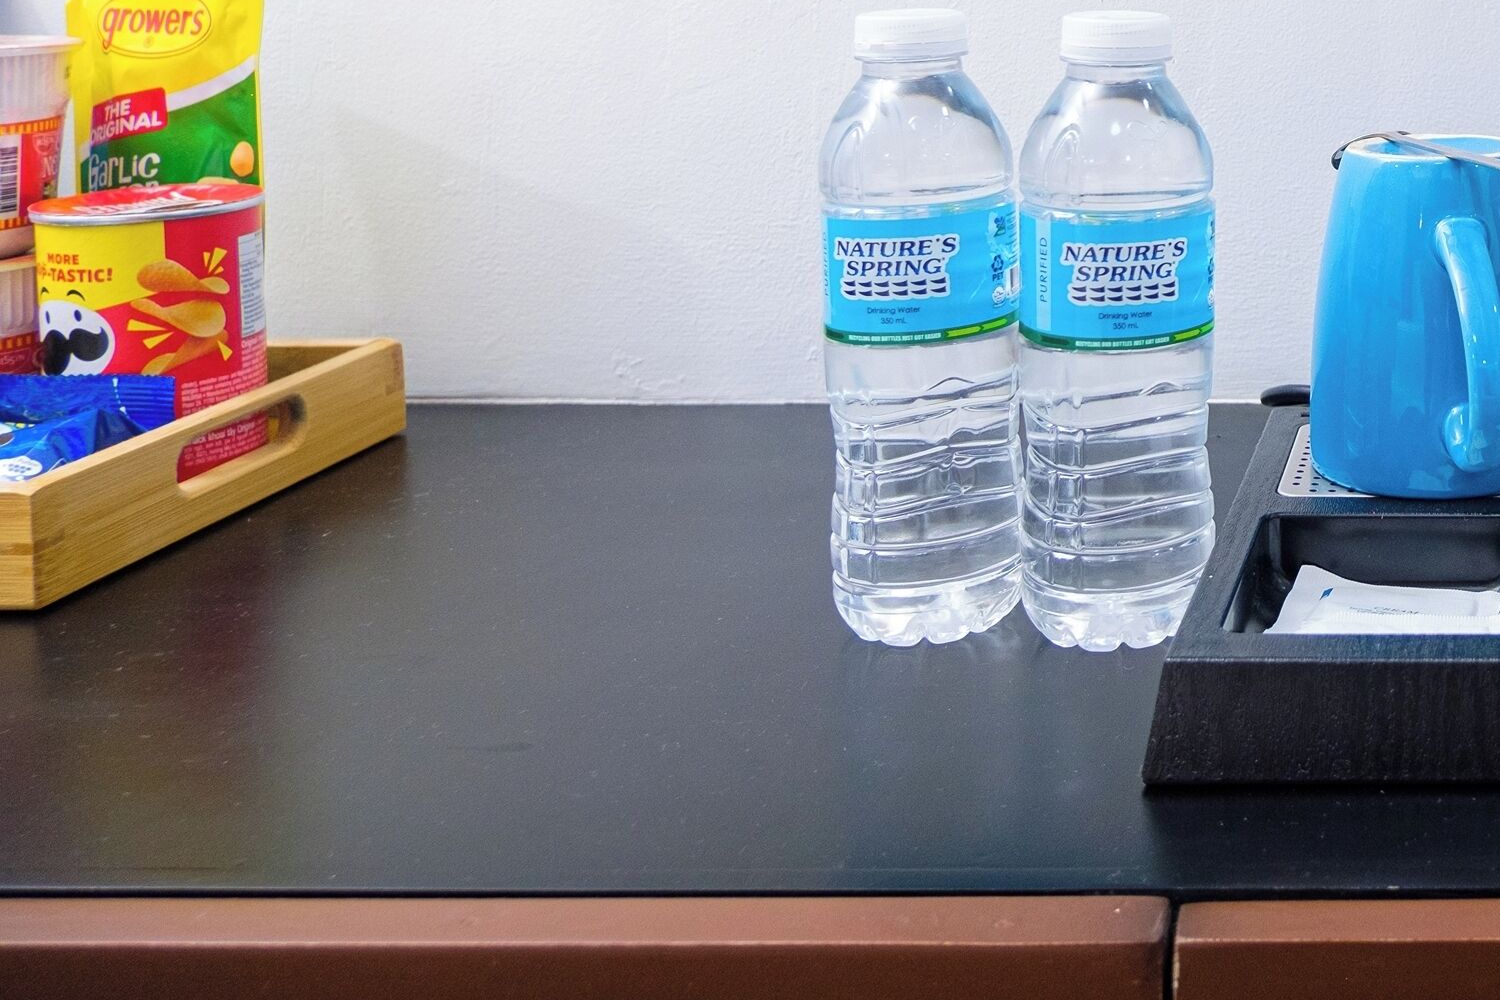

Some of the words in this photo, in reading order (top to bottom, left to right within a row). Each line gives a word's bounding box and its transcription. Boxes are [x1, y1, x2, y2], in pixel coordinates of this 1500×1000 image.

[102, 7, 204, 50] growers
[104, 98, 131, 121] THE
[90, 110, 162, 146] ORIGINAL
[836, 236, 957, 258] NATURE'S
[1063, 240, 1185, 263] NATURE'S
[46, 253, 80, 265] MORE
[846, 258, 943, 277] SPRING
[992, 271, 1004, 282] PET
[1039, 237, 1048, 303] PURIFIED
[1075, 261, 1173, 283] SPRING
[866, 306, 897, 315] Drinking
[897, 306, 921, 314] Water
[1098, 311, 1129, 320] Drinking
[880, 317, 895, 325] 350
[1112, 322, 1127, 330] 350
